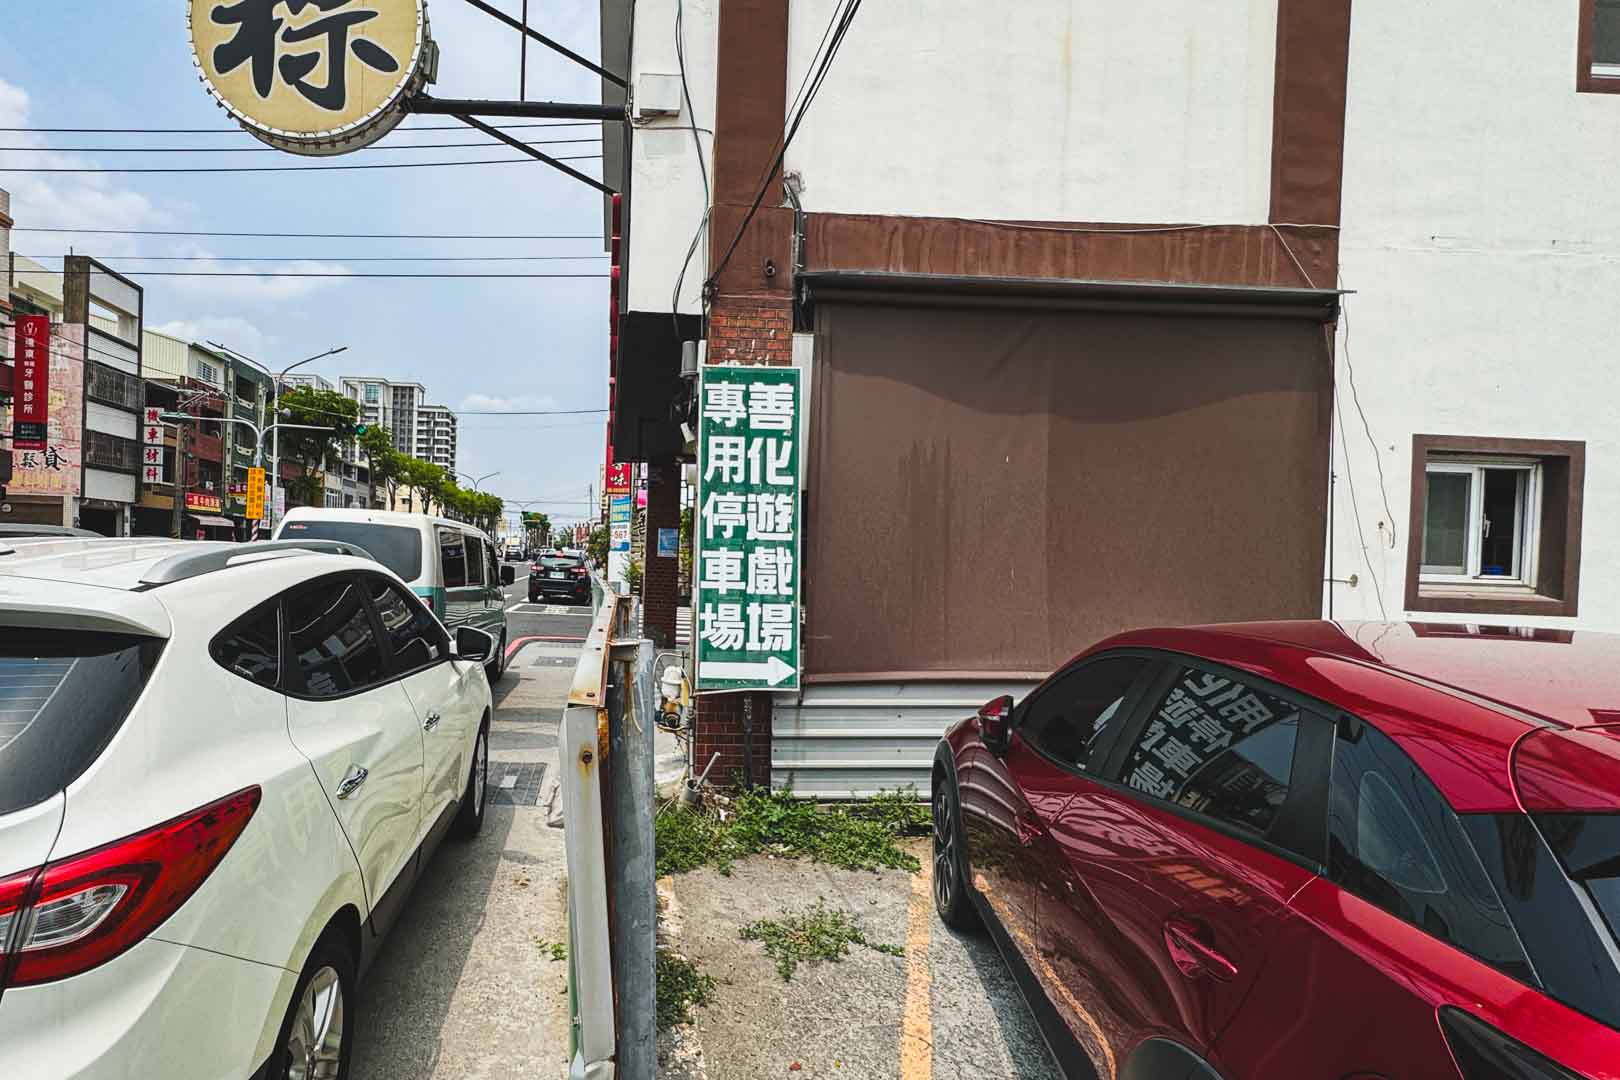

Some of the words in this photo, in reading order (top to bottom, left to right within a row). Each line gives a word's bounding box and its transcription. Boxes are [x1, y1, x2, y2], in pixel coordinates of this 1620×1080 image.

[701, 382, 746, 652] 專用停車場
[748, 382, 794, 652] 善化遊戲場
